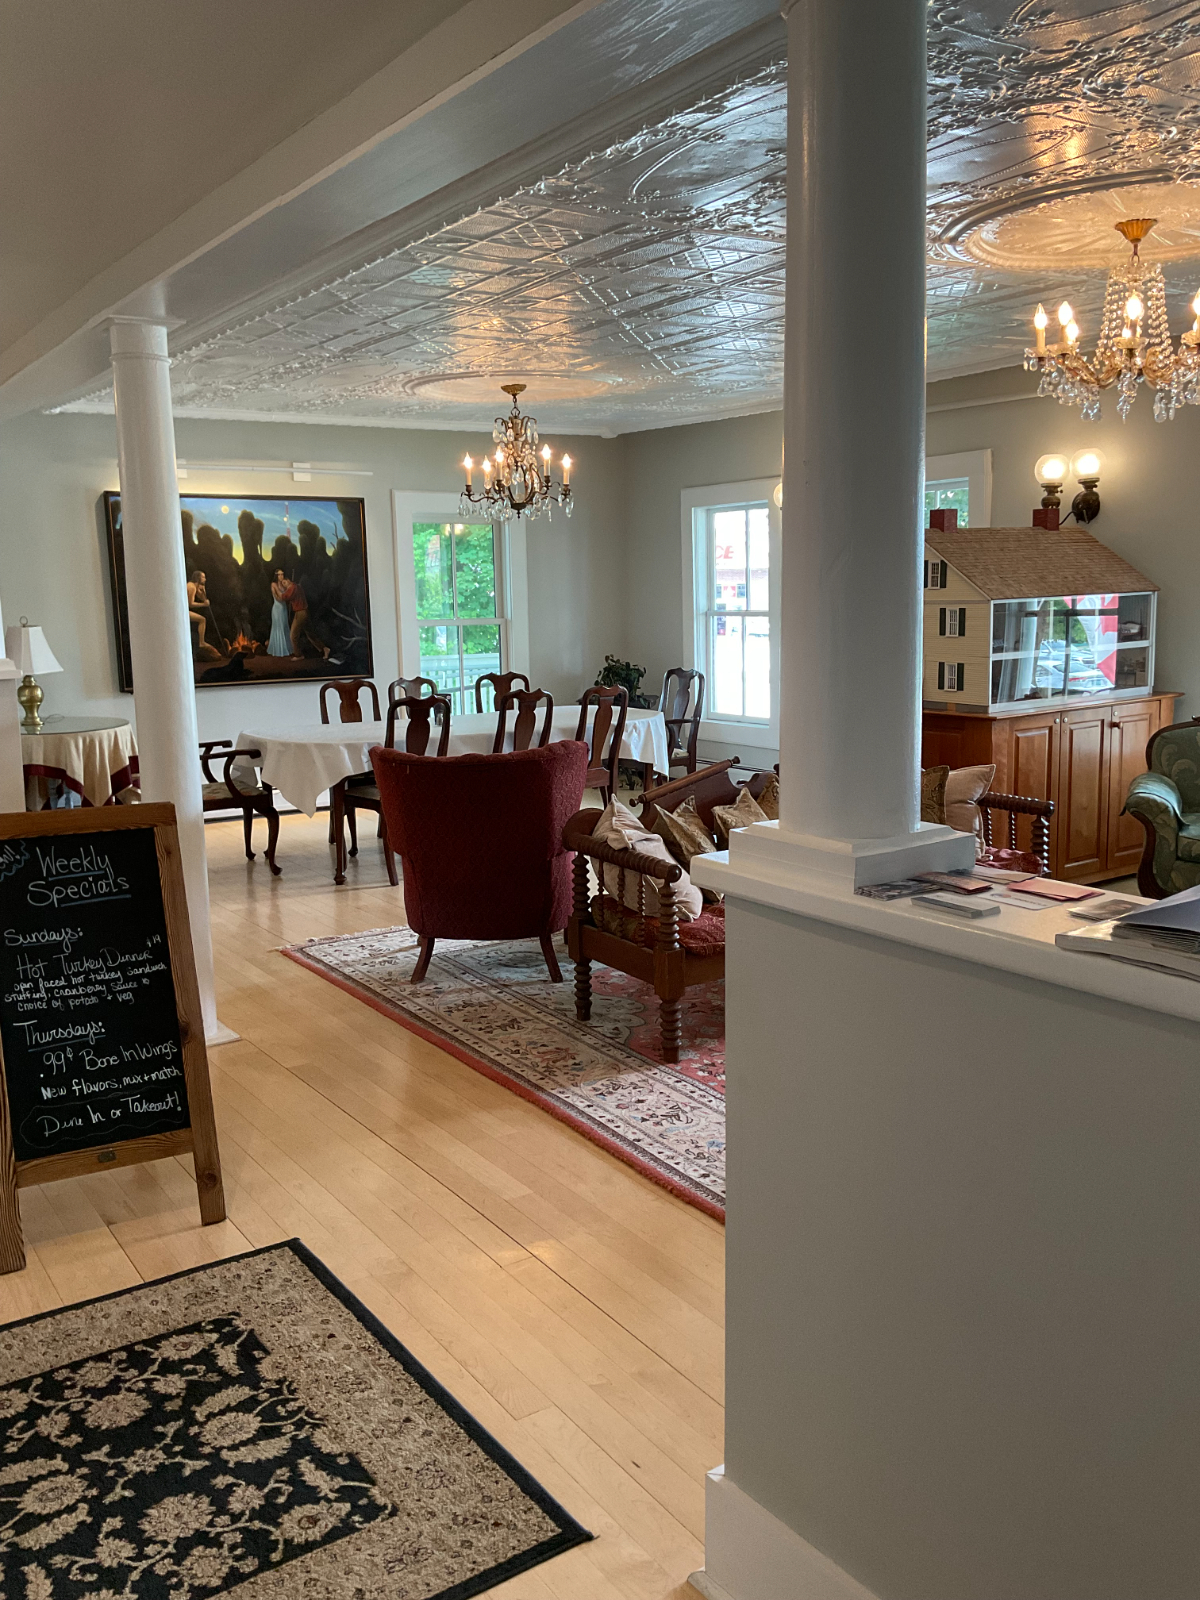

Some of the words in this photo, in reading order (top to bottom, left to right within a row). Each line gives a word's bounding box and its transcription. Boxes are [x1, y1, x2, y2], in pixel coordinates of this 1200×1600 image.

[36, 845, 114, 879] Weekly
[27, 876, 130, 907] Specials
[4, 927, 83, 952] Sundays:
[16, 953, 48, 979] Hot
[53, 953, 106, 975] Turkey
[18, 1001, 47, 1011] choice
[13, 1020, 105, 1045] Thursdays:
[79, 1049, 120, 1070] Bone
[135, 1040, 178, 1060] Wings
[41, 1086, 67, 1100] New
[36, 1116, 84, 1137] Dine
[87, 1105, 105, 1124] In
[111, 1109, 122, 1119] or
[120, 1091, 182, 1113] Takeout!
